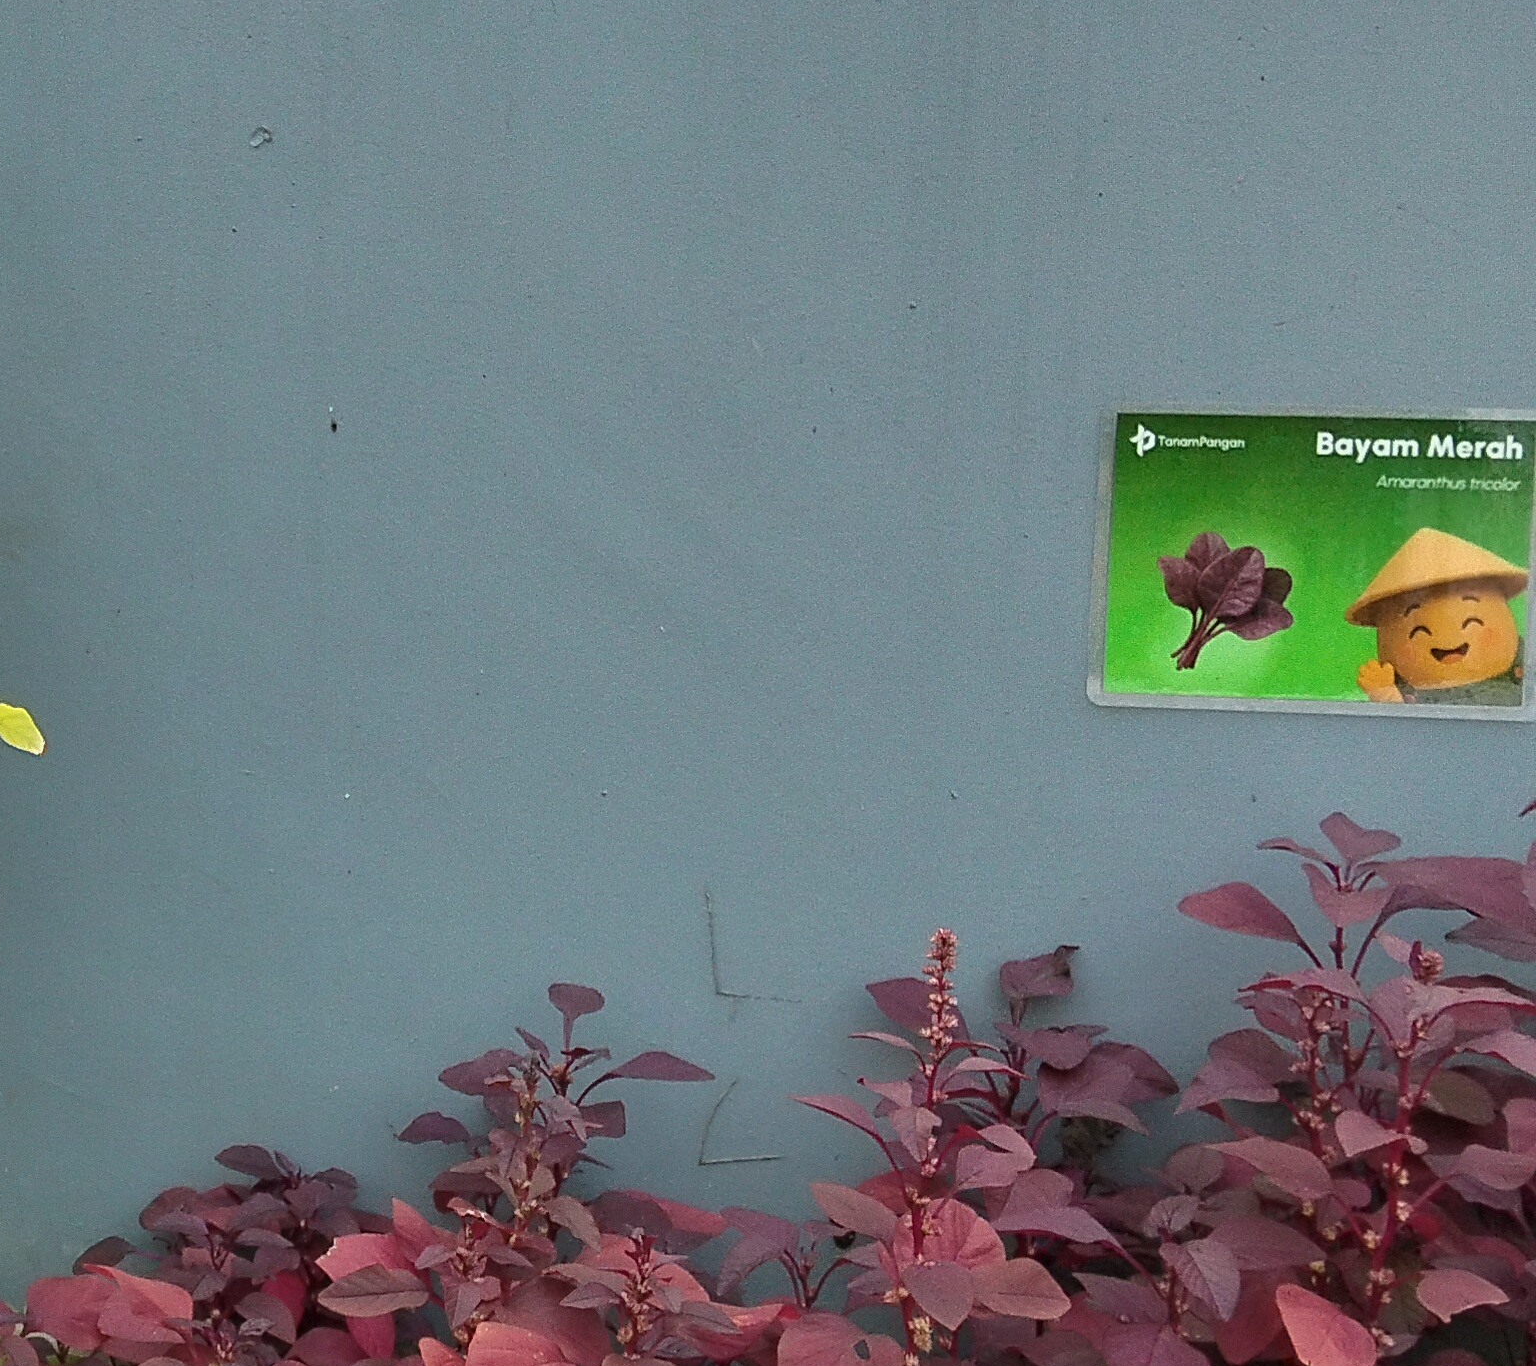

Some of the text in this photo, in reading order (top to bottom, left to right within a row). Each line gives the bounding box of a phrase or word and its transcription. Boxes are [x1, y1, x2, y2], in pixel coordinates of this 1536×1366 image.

[1158, 435, 1245, 451] TanamPangan
[1316, 432, 1524, 464] Bayam Merah
[1376, 475, 1522, 491] Amaranthus tricolor
